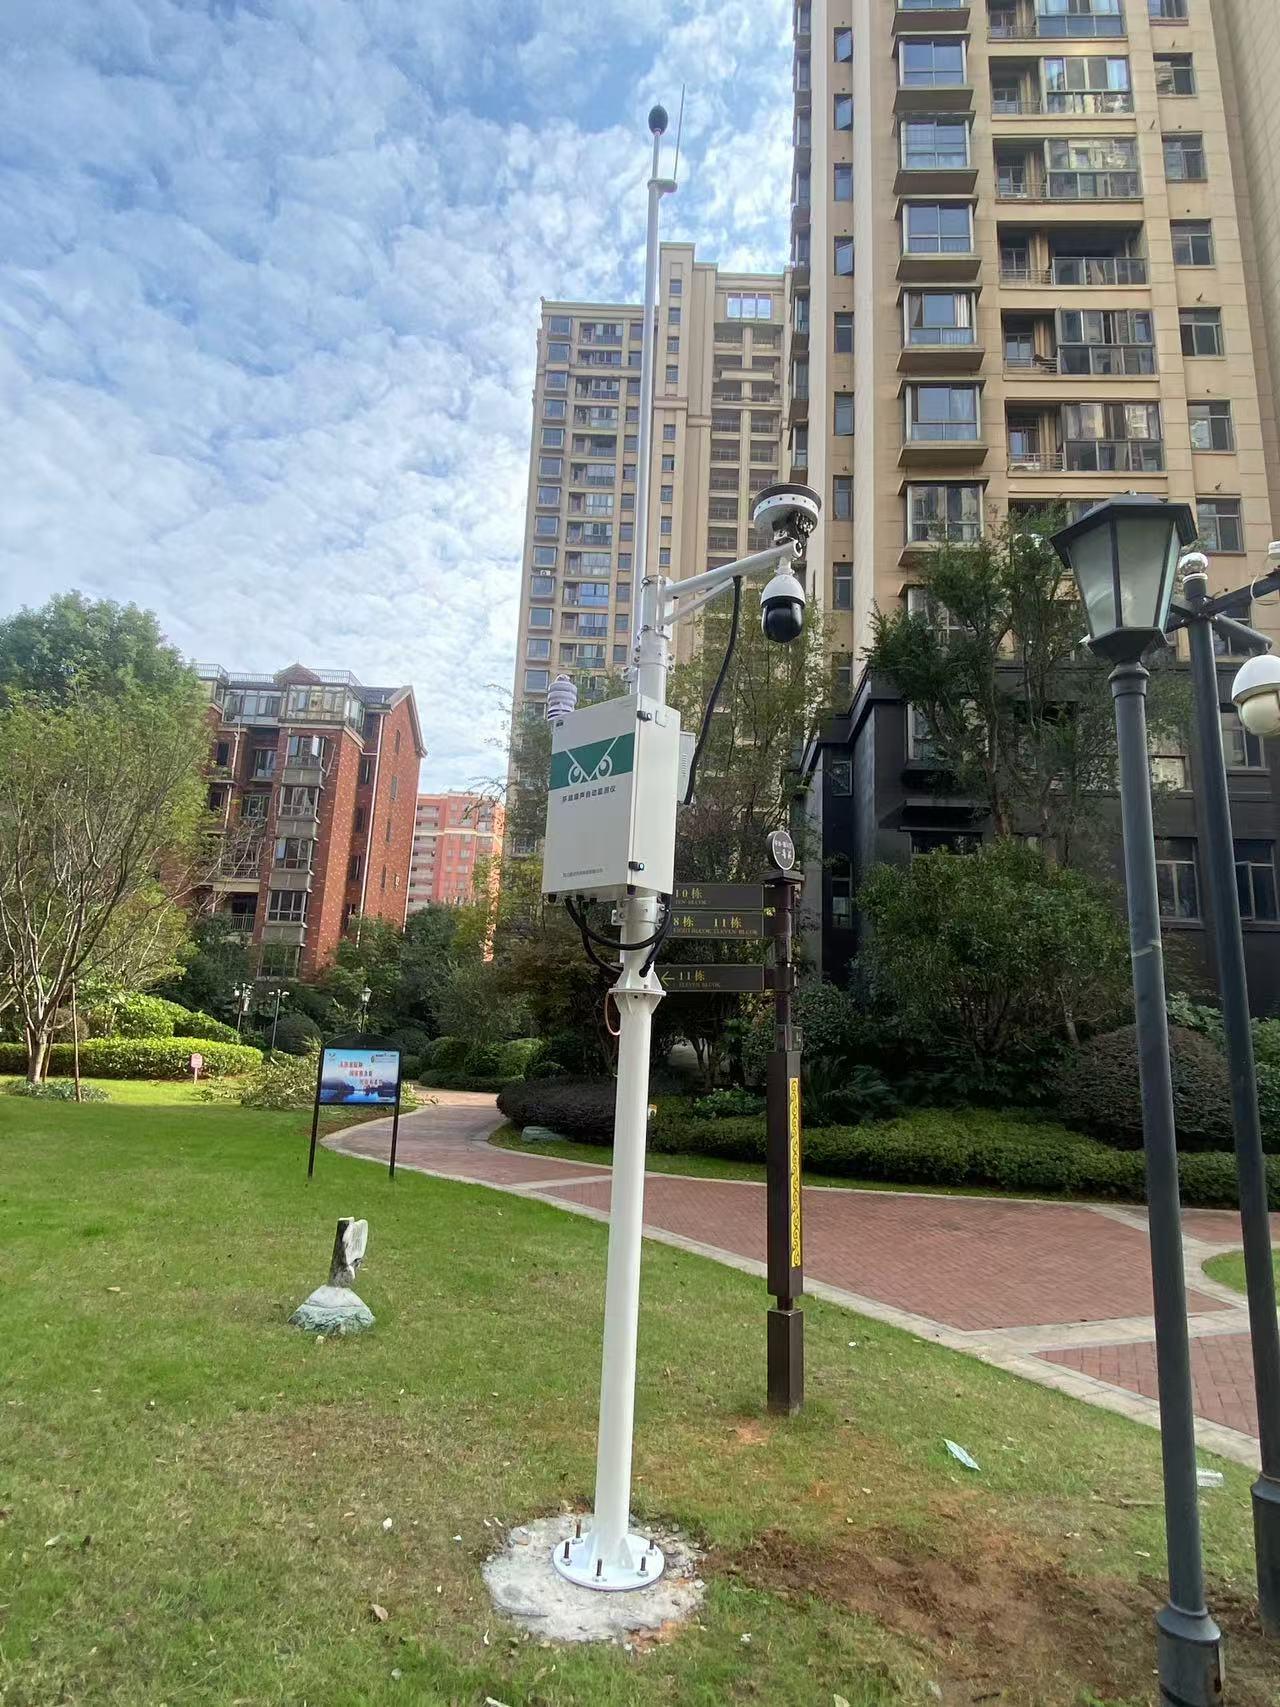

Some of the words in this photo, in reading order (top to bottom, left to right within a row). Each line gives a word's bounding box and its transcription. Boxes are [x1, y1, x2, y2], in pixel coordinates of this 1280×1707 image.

[675, 888, 703, 899] 10栋
[673, 915, 695, 928] 8栋
[714, 916, 742, 929] 11栋
